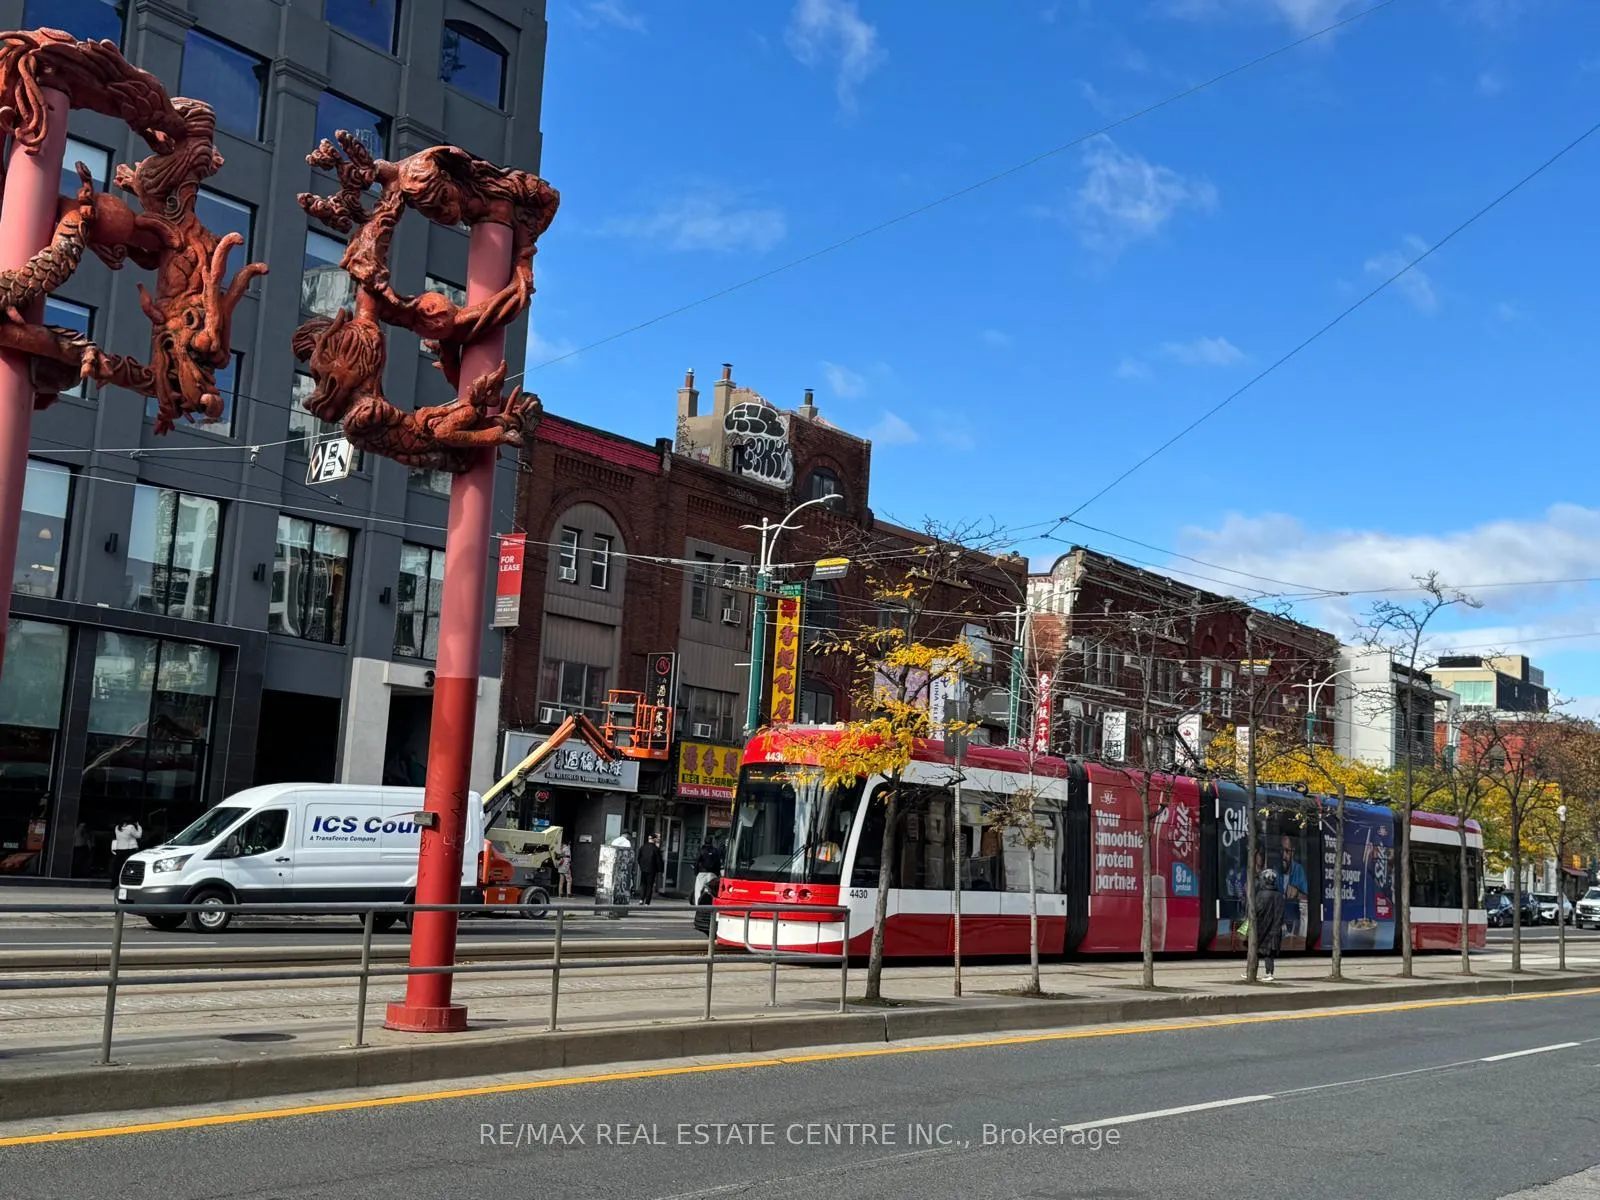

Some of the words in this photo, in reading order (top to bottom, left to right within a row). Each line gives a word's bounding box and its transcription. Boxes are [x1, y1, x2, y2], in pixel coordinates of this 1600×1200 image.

[500, 555, 515, 564] FOR
[500, 564, 520, 572] LEASE
[312, 815, 359, 833] ICS
[1095, 809, 1121, 828] Your
[1173, 801, 1189, 857] Silk
[1095, 829, 1144, 849] smoothie
[1095, 849, 1134, 870] protein
[1095, 872, 1138, 894] partner.
[849, 889, 868, 899] 4430
